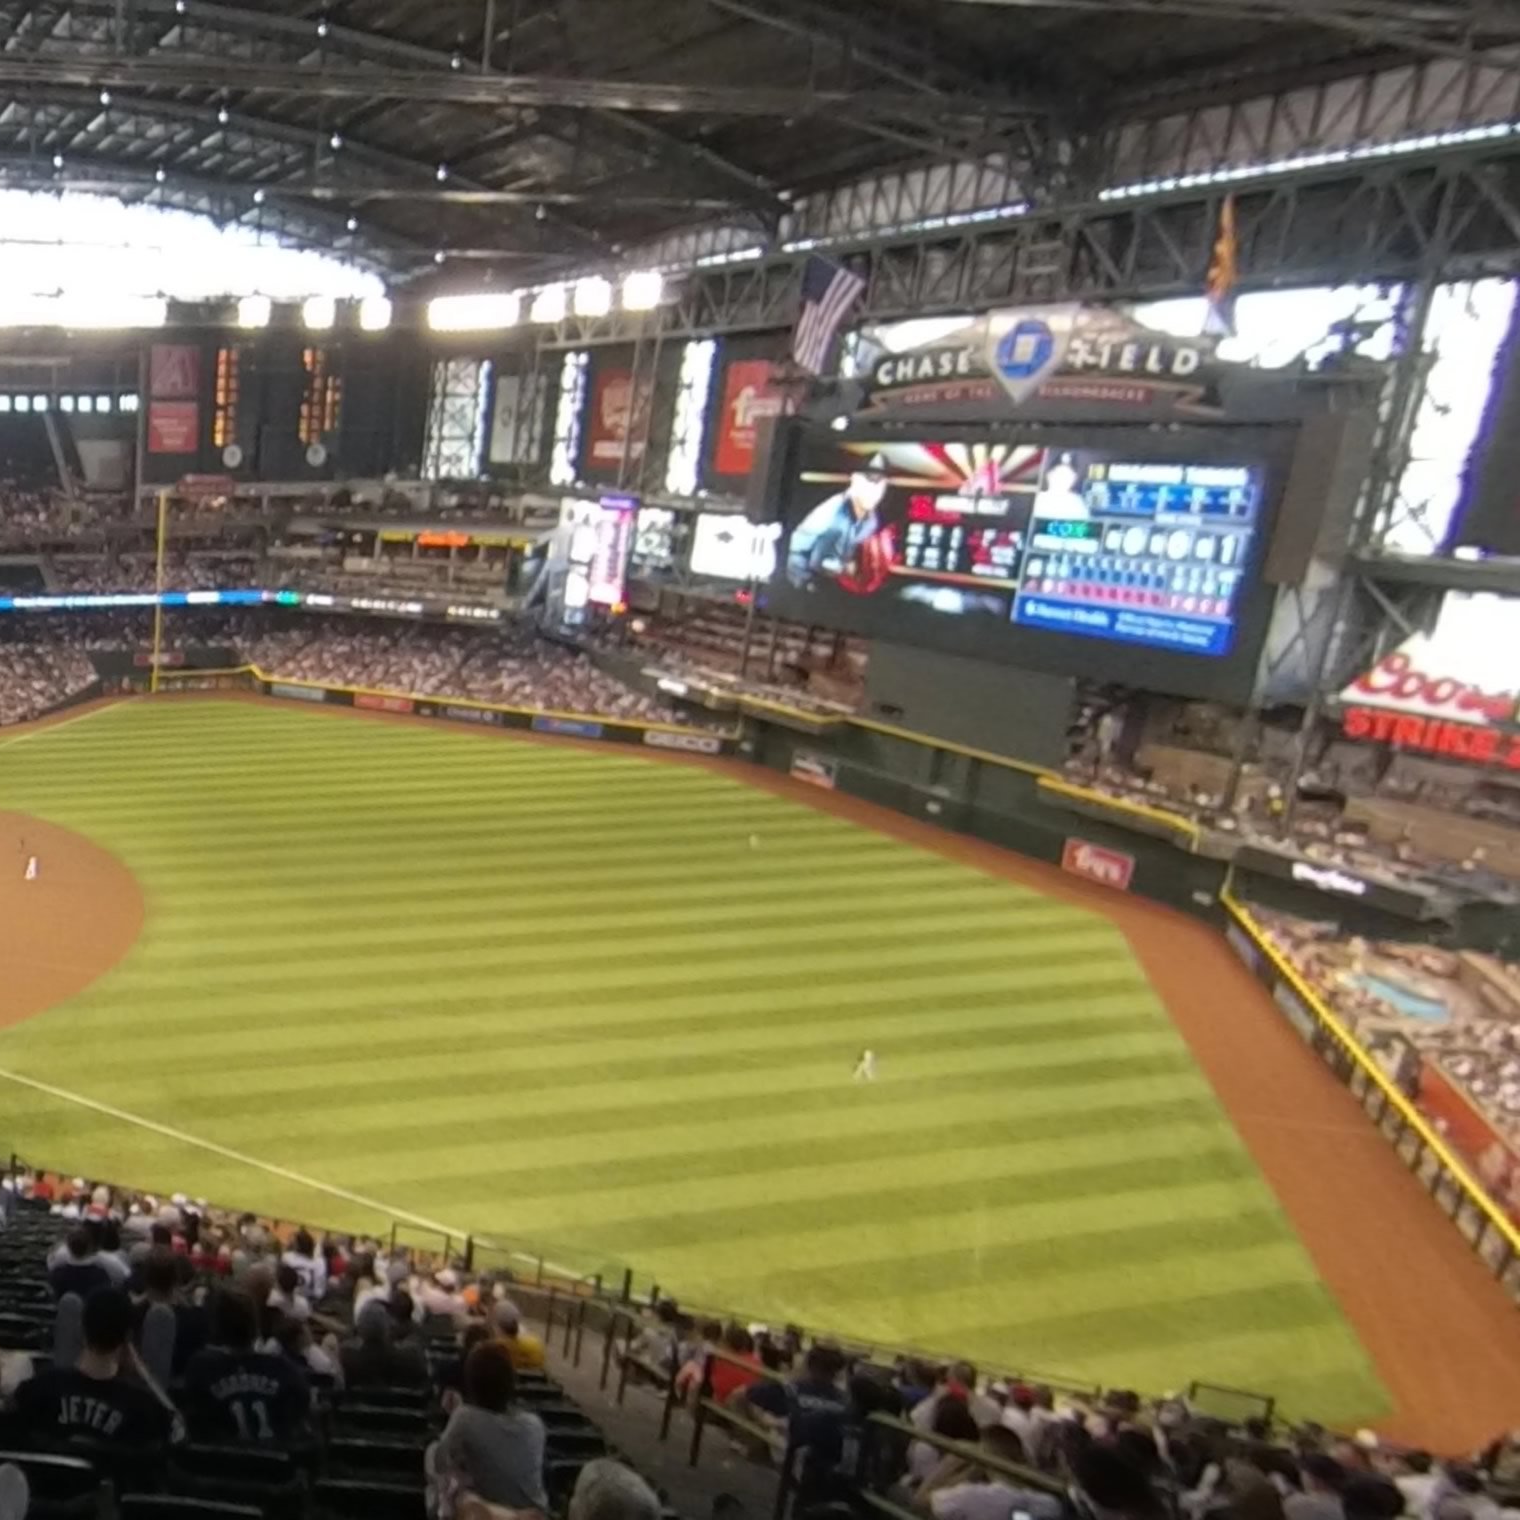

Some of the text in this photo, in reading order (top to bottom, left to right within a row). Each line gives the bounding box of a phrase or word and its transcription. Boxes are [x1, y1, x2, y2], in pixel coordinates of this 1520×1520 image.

[876, 339, 1199, 386] CHASE FIELD
[645, 730, 720, 754] GEICO
[1343, 707, 1500, 760] STRIKE
[57, 1394, 124, 1435] JETER
[230, 1399, 275, 1440] 11
